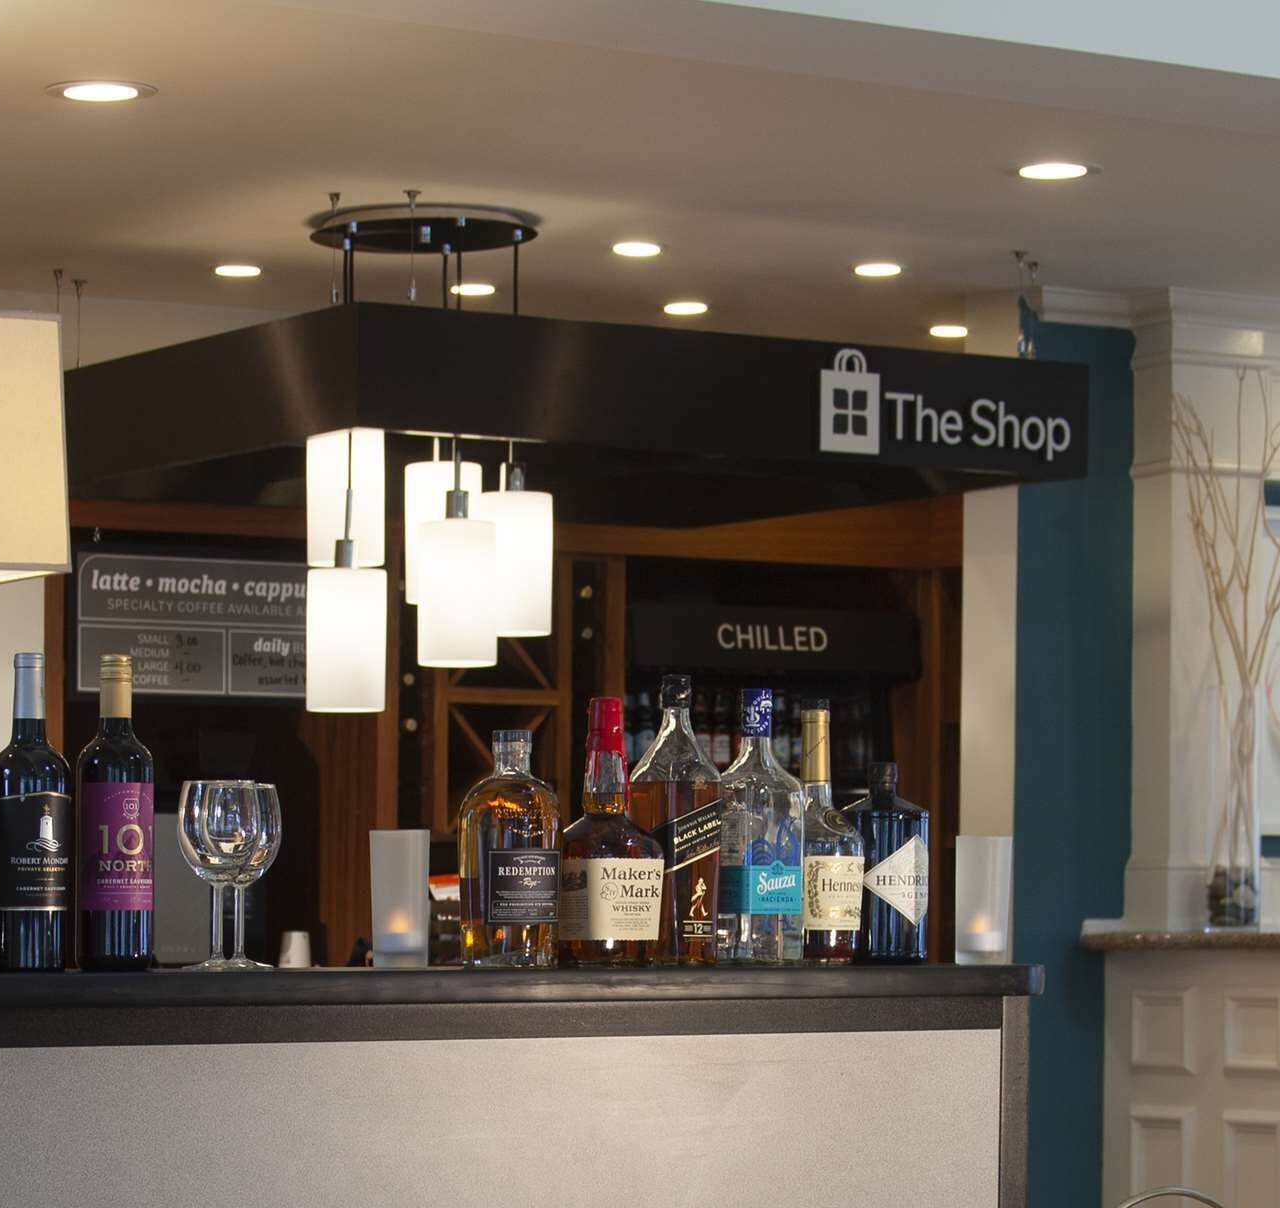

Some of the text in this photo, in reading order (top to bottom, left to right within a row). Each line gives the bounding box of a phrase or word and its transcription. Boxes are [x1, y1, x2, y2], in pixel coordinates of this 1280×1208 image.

[884, 391, 1072, 462] The Shop
[91, 568, 141, 592] latte
[157, 574, 227, 596] mocha
[106, 597, 173, 613] SPECIALTY
[176, 600, 224, 615] COFFEE
[227, 602, 292, 617] AVAILABLE
[136, 633, 169, 646] SMALL
[716, 623, 829, 653] CHILLED
[129, 647, 170, 658] MEDIUM
[253, 637, 291, 656] daily
[138, 659, 170, 673] LARGE
[673, 819, 722, 845] BLACK LABEL
[498, 866, 556, 877] REDEMPTION
[601, 866, 662, 881] Maker's
[521, 877, 538, 889] Rye
[756, 871, 796, 896] Sauza
[619, 884, 660, 899] Mark
[611, 904, 652, 913] WHISKY
[693, 923, 704, 935] 12
